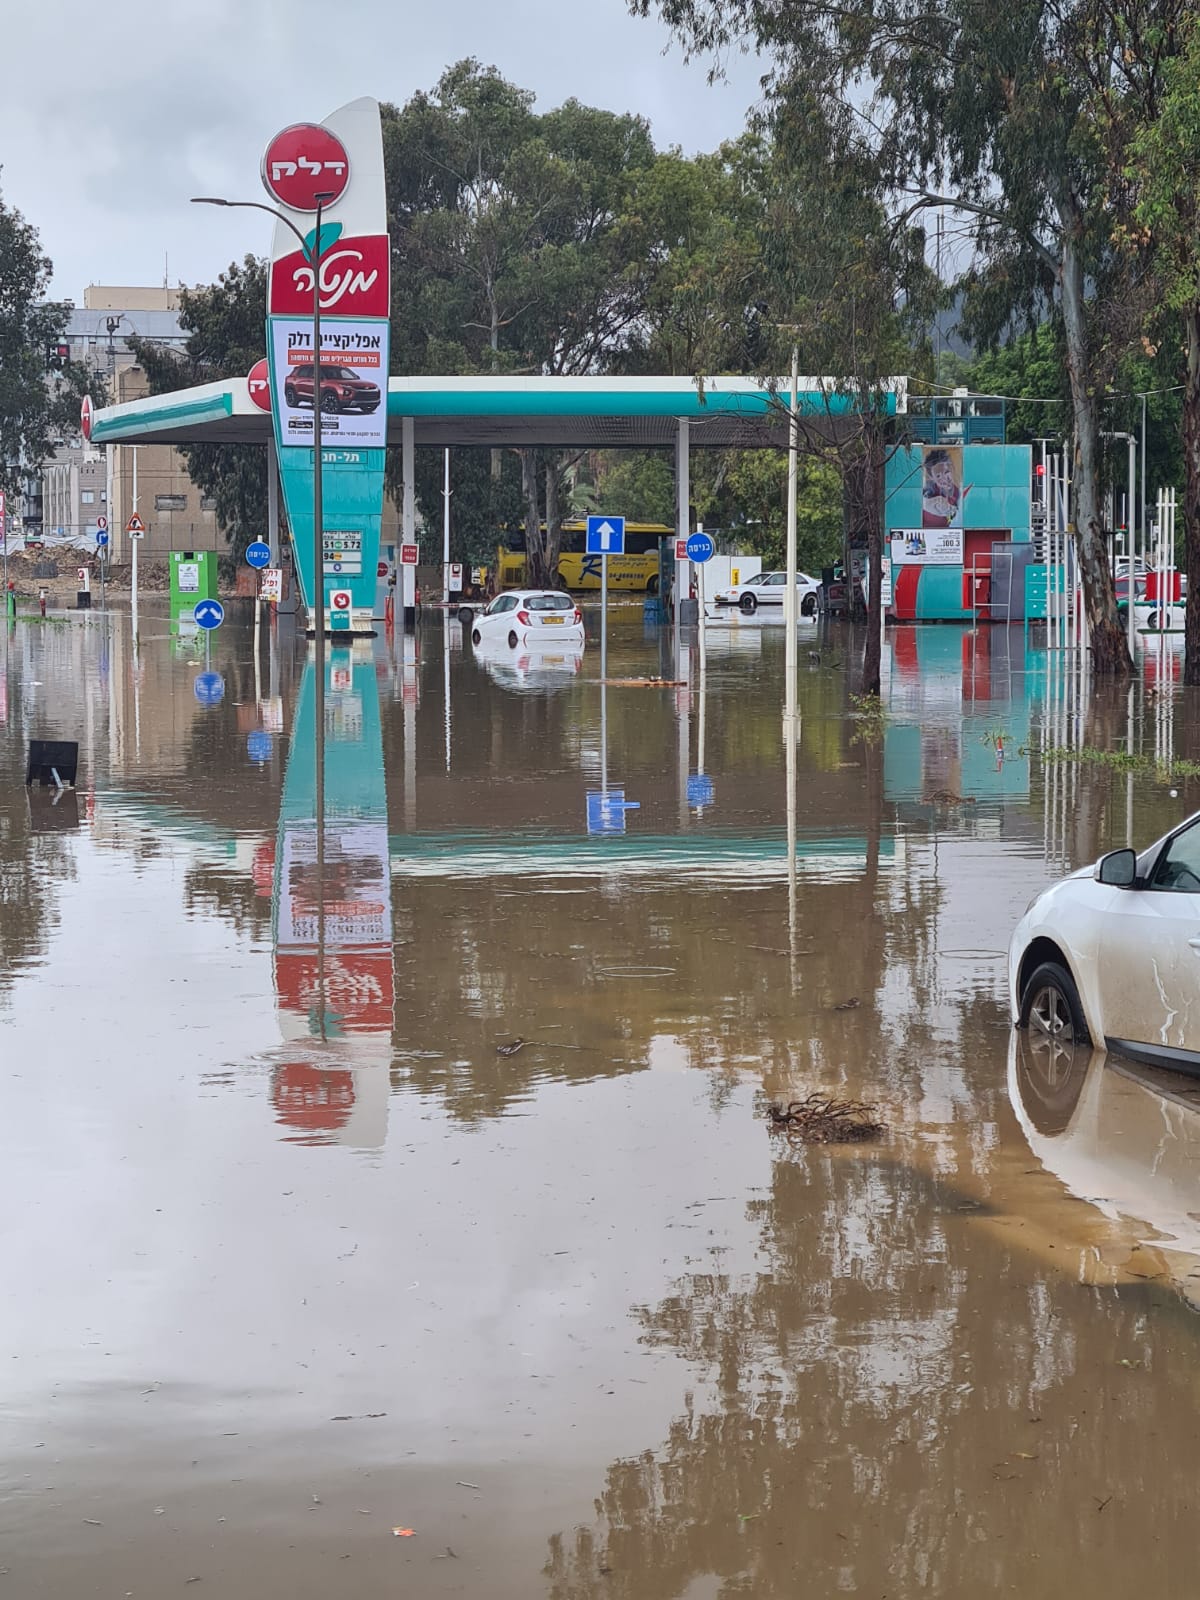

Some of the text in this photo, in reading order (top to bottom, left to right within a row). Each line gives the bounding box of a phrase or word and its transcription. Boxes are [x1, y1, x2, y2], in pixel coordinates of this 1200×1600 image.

[271, 155, 346, 182] דלק
[292, 250, 378, 309] מנטה
[288, 331, 311, 349] דלק
[323, 452, 360, 463] תל-חנ
[248, 550, 270, 559] כניסה
[688, 543, 711, 553] כניסה
